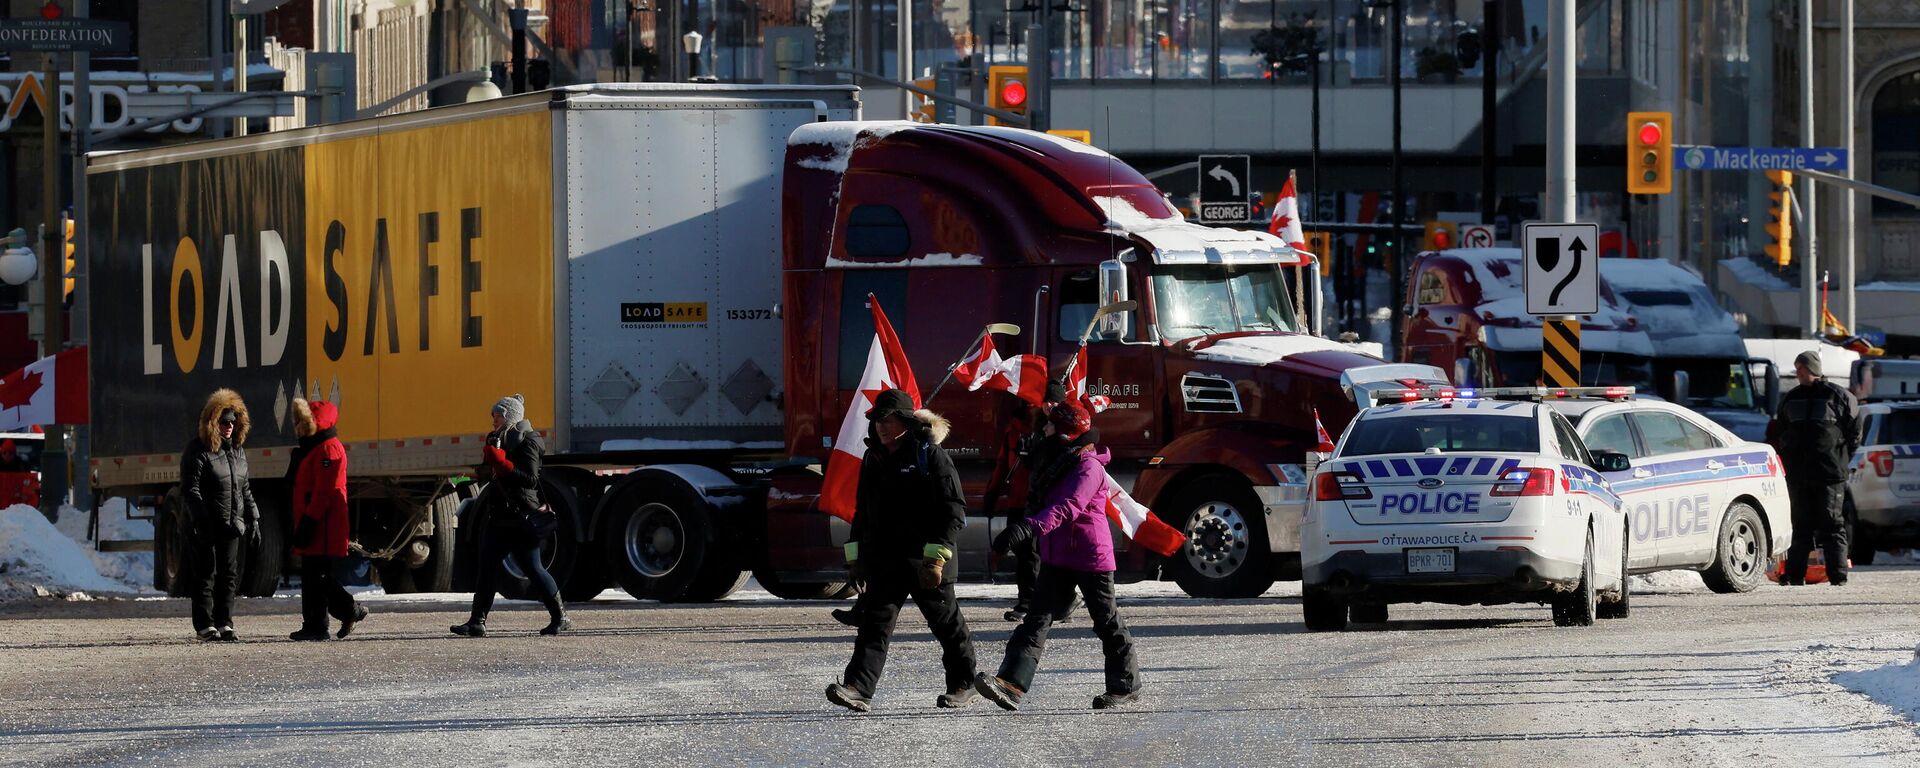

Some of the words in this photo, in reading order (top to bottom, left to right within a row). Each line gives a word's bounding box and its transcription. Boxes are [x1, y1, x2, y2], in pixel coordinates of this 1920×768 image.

[1714, 149, 1805, 169] Mackenzie
[1204, 206, 1245, 219] GEORGE
[142, 229, 291, 375] LOAD
[323, 207, 483, 362] SAFE
[626, 308, 661, 317] LOAD
[667, 308, 702, 317] SAFE
[727, 309, 771, 320] 153372
[1103, 385, 1139, 396] SAFE
[1380, 492, 1482, 516] POLICE
[1382, 535, 1477, 546] OTTAWAPOLICE.CA
